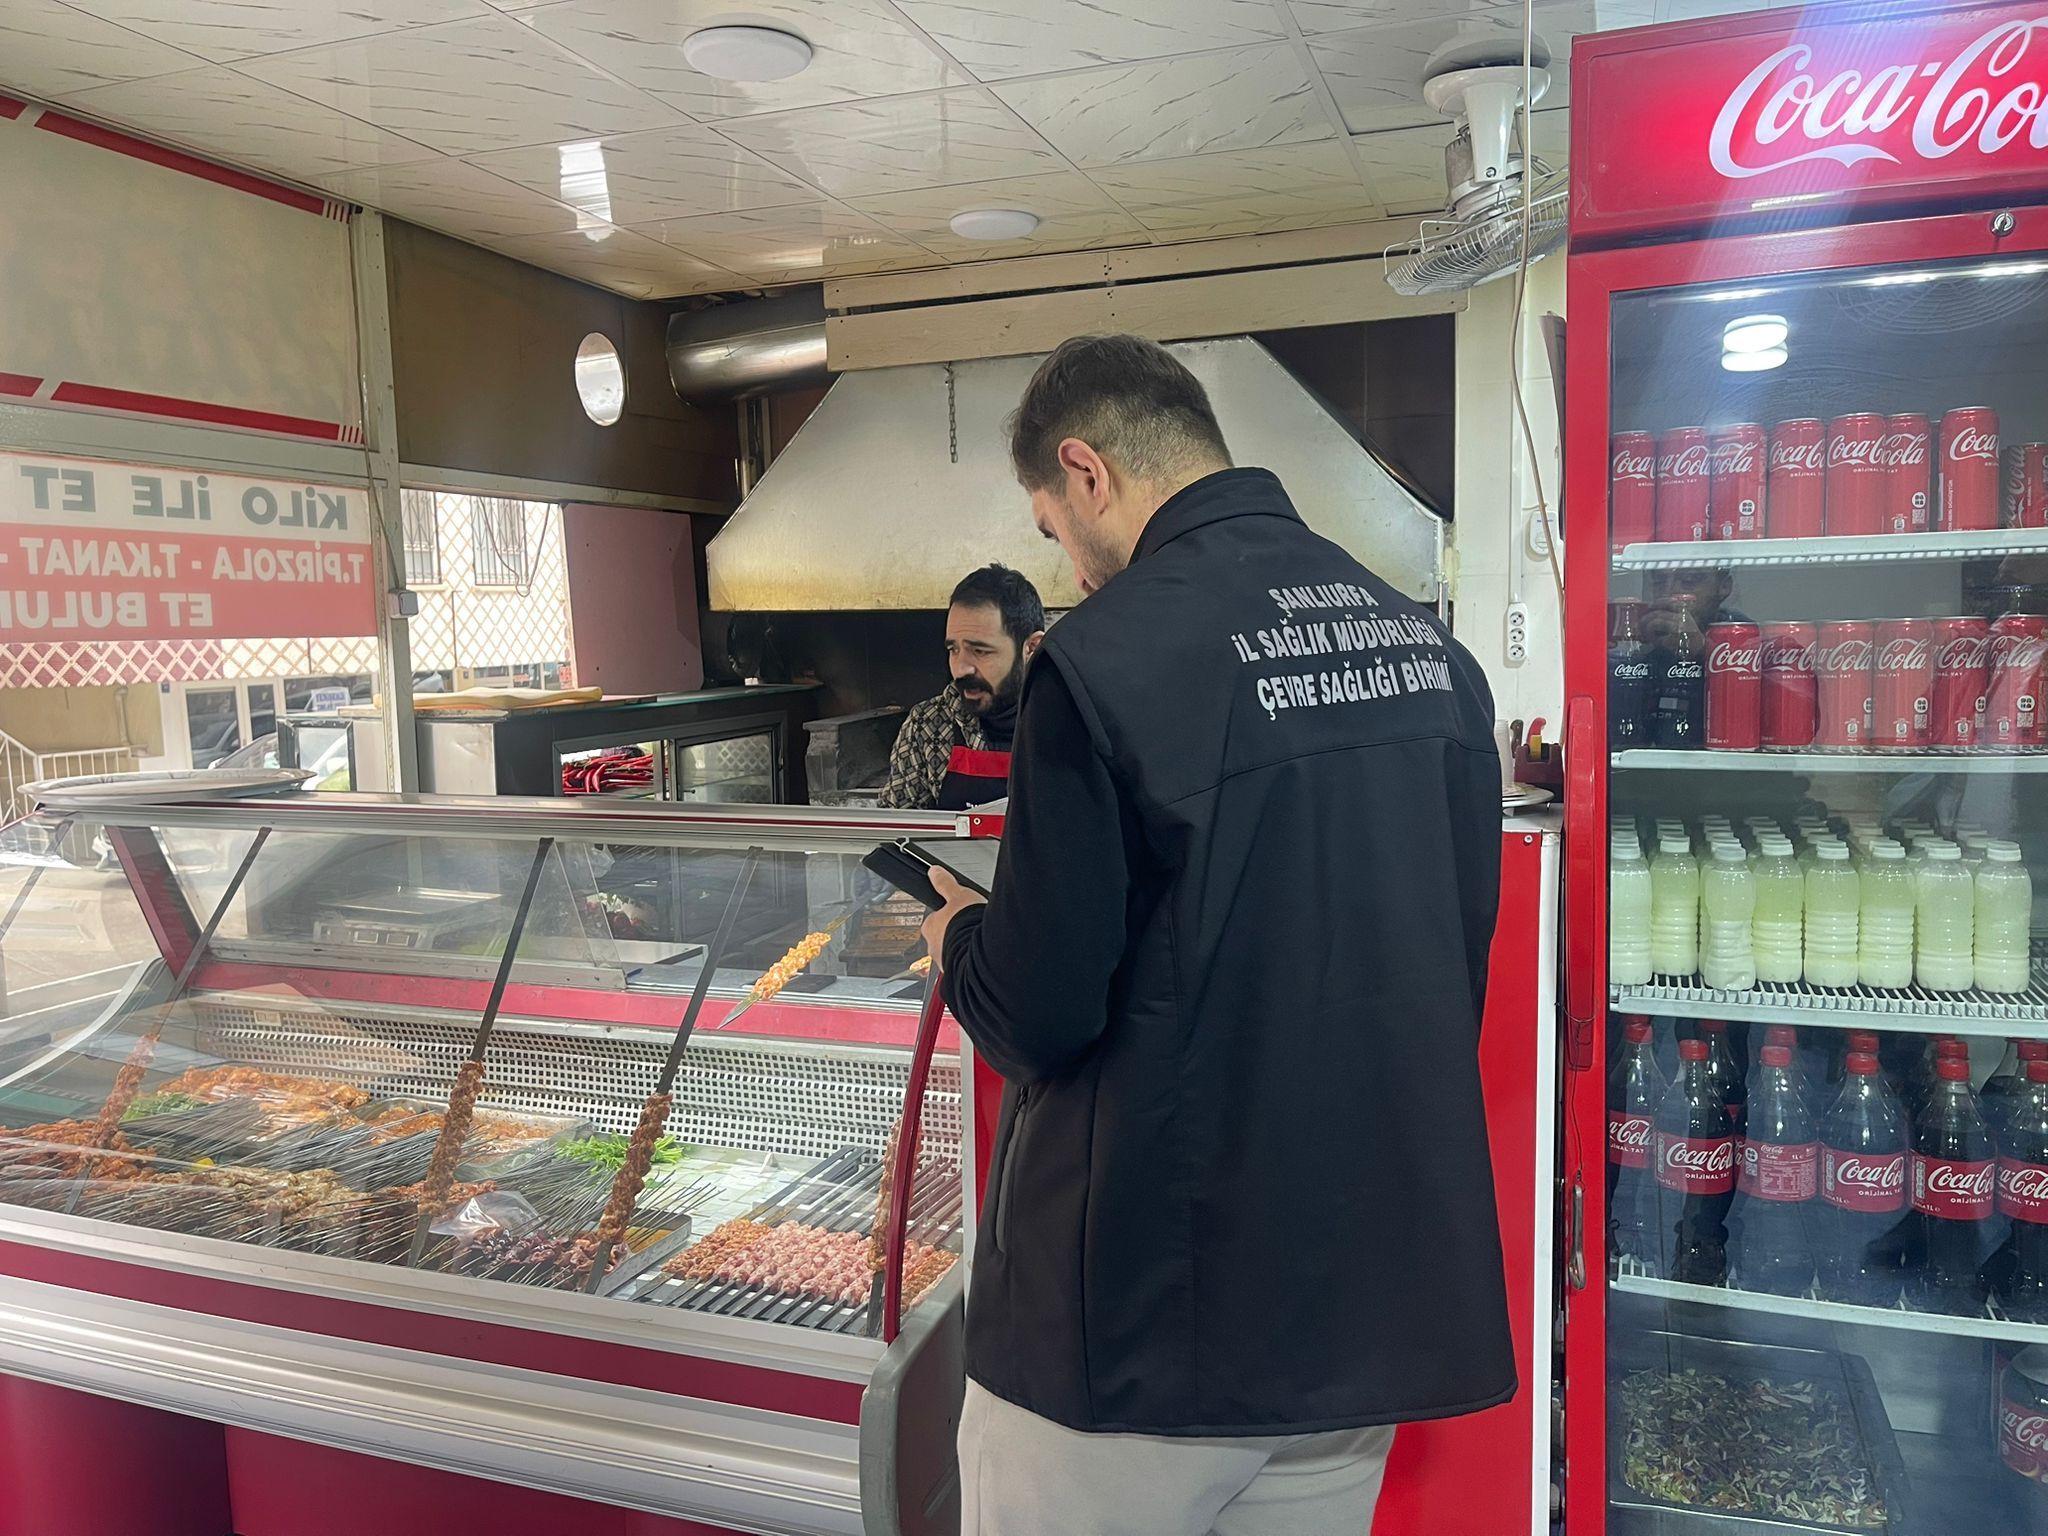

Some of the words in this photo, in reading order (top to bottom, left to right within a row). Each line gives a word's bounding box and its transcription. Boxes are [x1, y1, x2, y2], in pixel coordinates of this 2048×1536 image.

[1268, 582, 1379, 618] ŞANLIURFA
[1256, 617, 1333, 659] SAĞLIK
[1331, 613, 1443, 652] MÜDÜRLÜĞÜ
[1257, 674, 1318, 721] ÇEVRE
[1320, 655, 1401, 705] SAĞLIĞI
[1400, 652, 1454, 693] BİRİMİ
